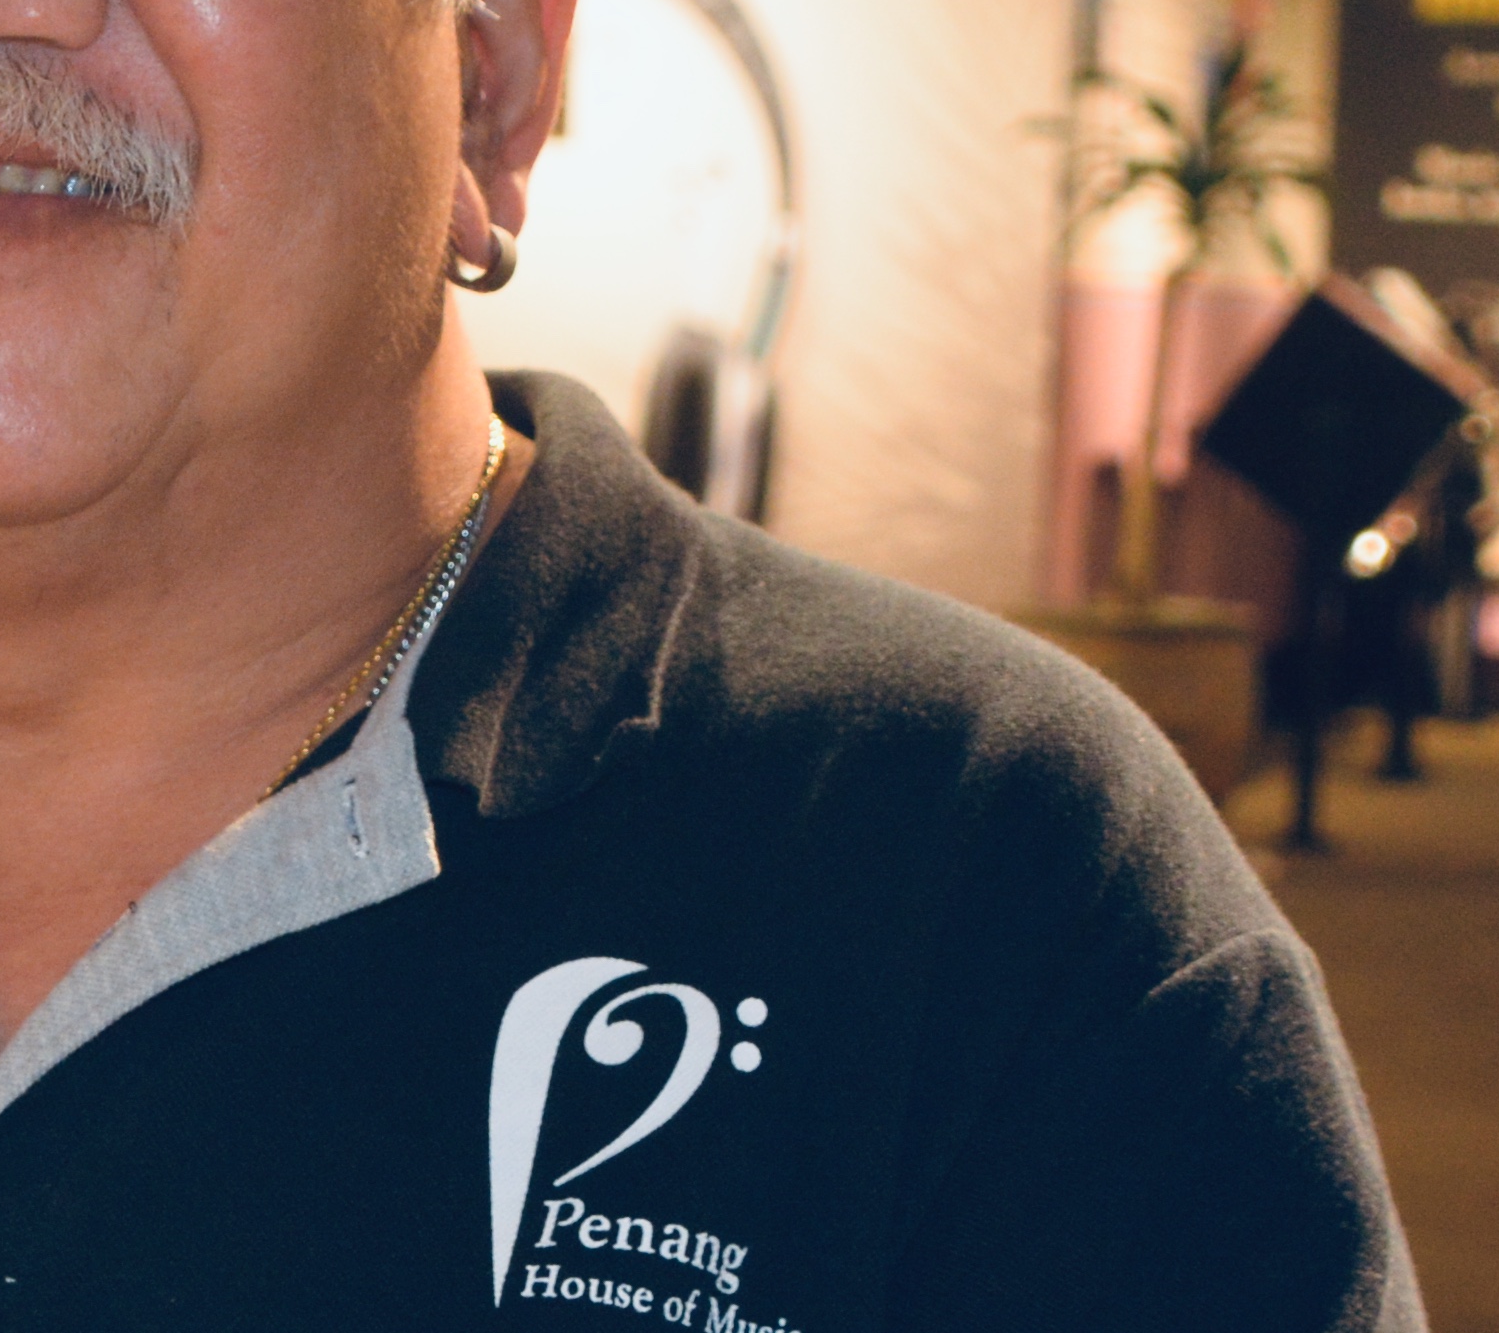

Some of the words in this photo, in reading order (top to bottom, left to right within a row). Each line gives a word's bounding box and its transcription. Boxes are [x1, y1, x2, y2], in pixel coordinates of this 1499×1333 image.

[535, 1196, 748, 1295] Penang
[520, 1265, 653, 1313] House
[663, 1289, 701, 1327] of
